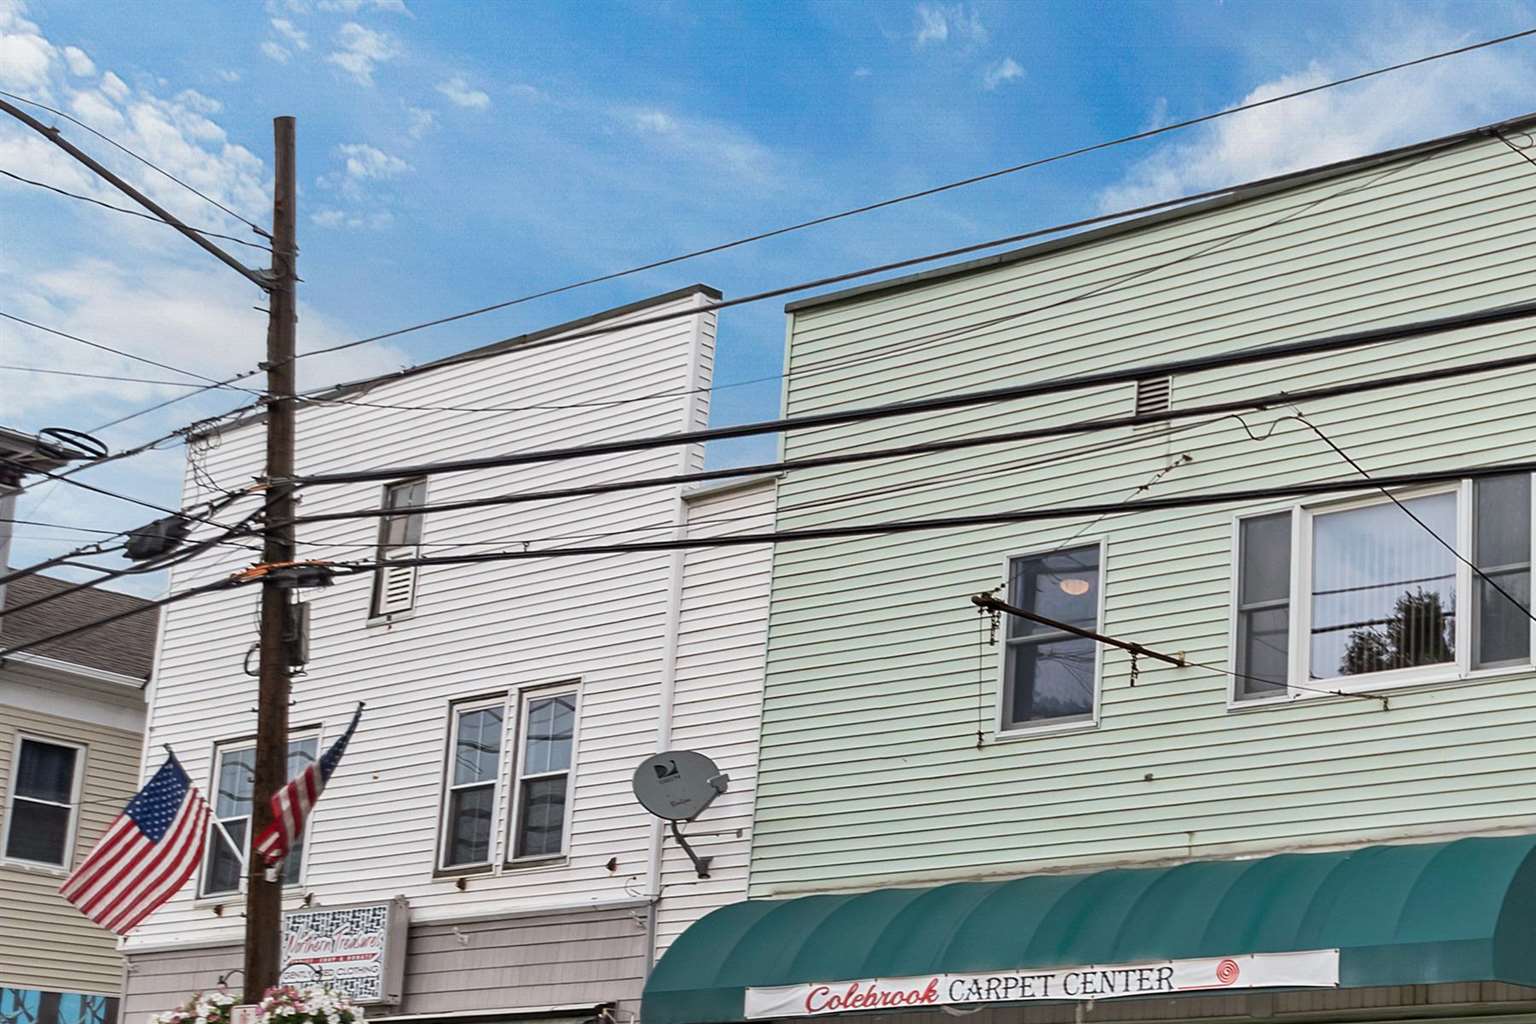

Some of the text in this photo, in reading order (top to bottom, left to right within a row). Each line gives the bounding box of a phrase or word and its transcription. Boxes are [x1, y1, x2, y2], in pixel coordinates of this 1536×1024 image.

[286, 931, 333, 953] Northern
[337, 965, 379, 977] CLOTHING
[804, 966, 1175, 1013] Colebrook CARPET CENTER
